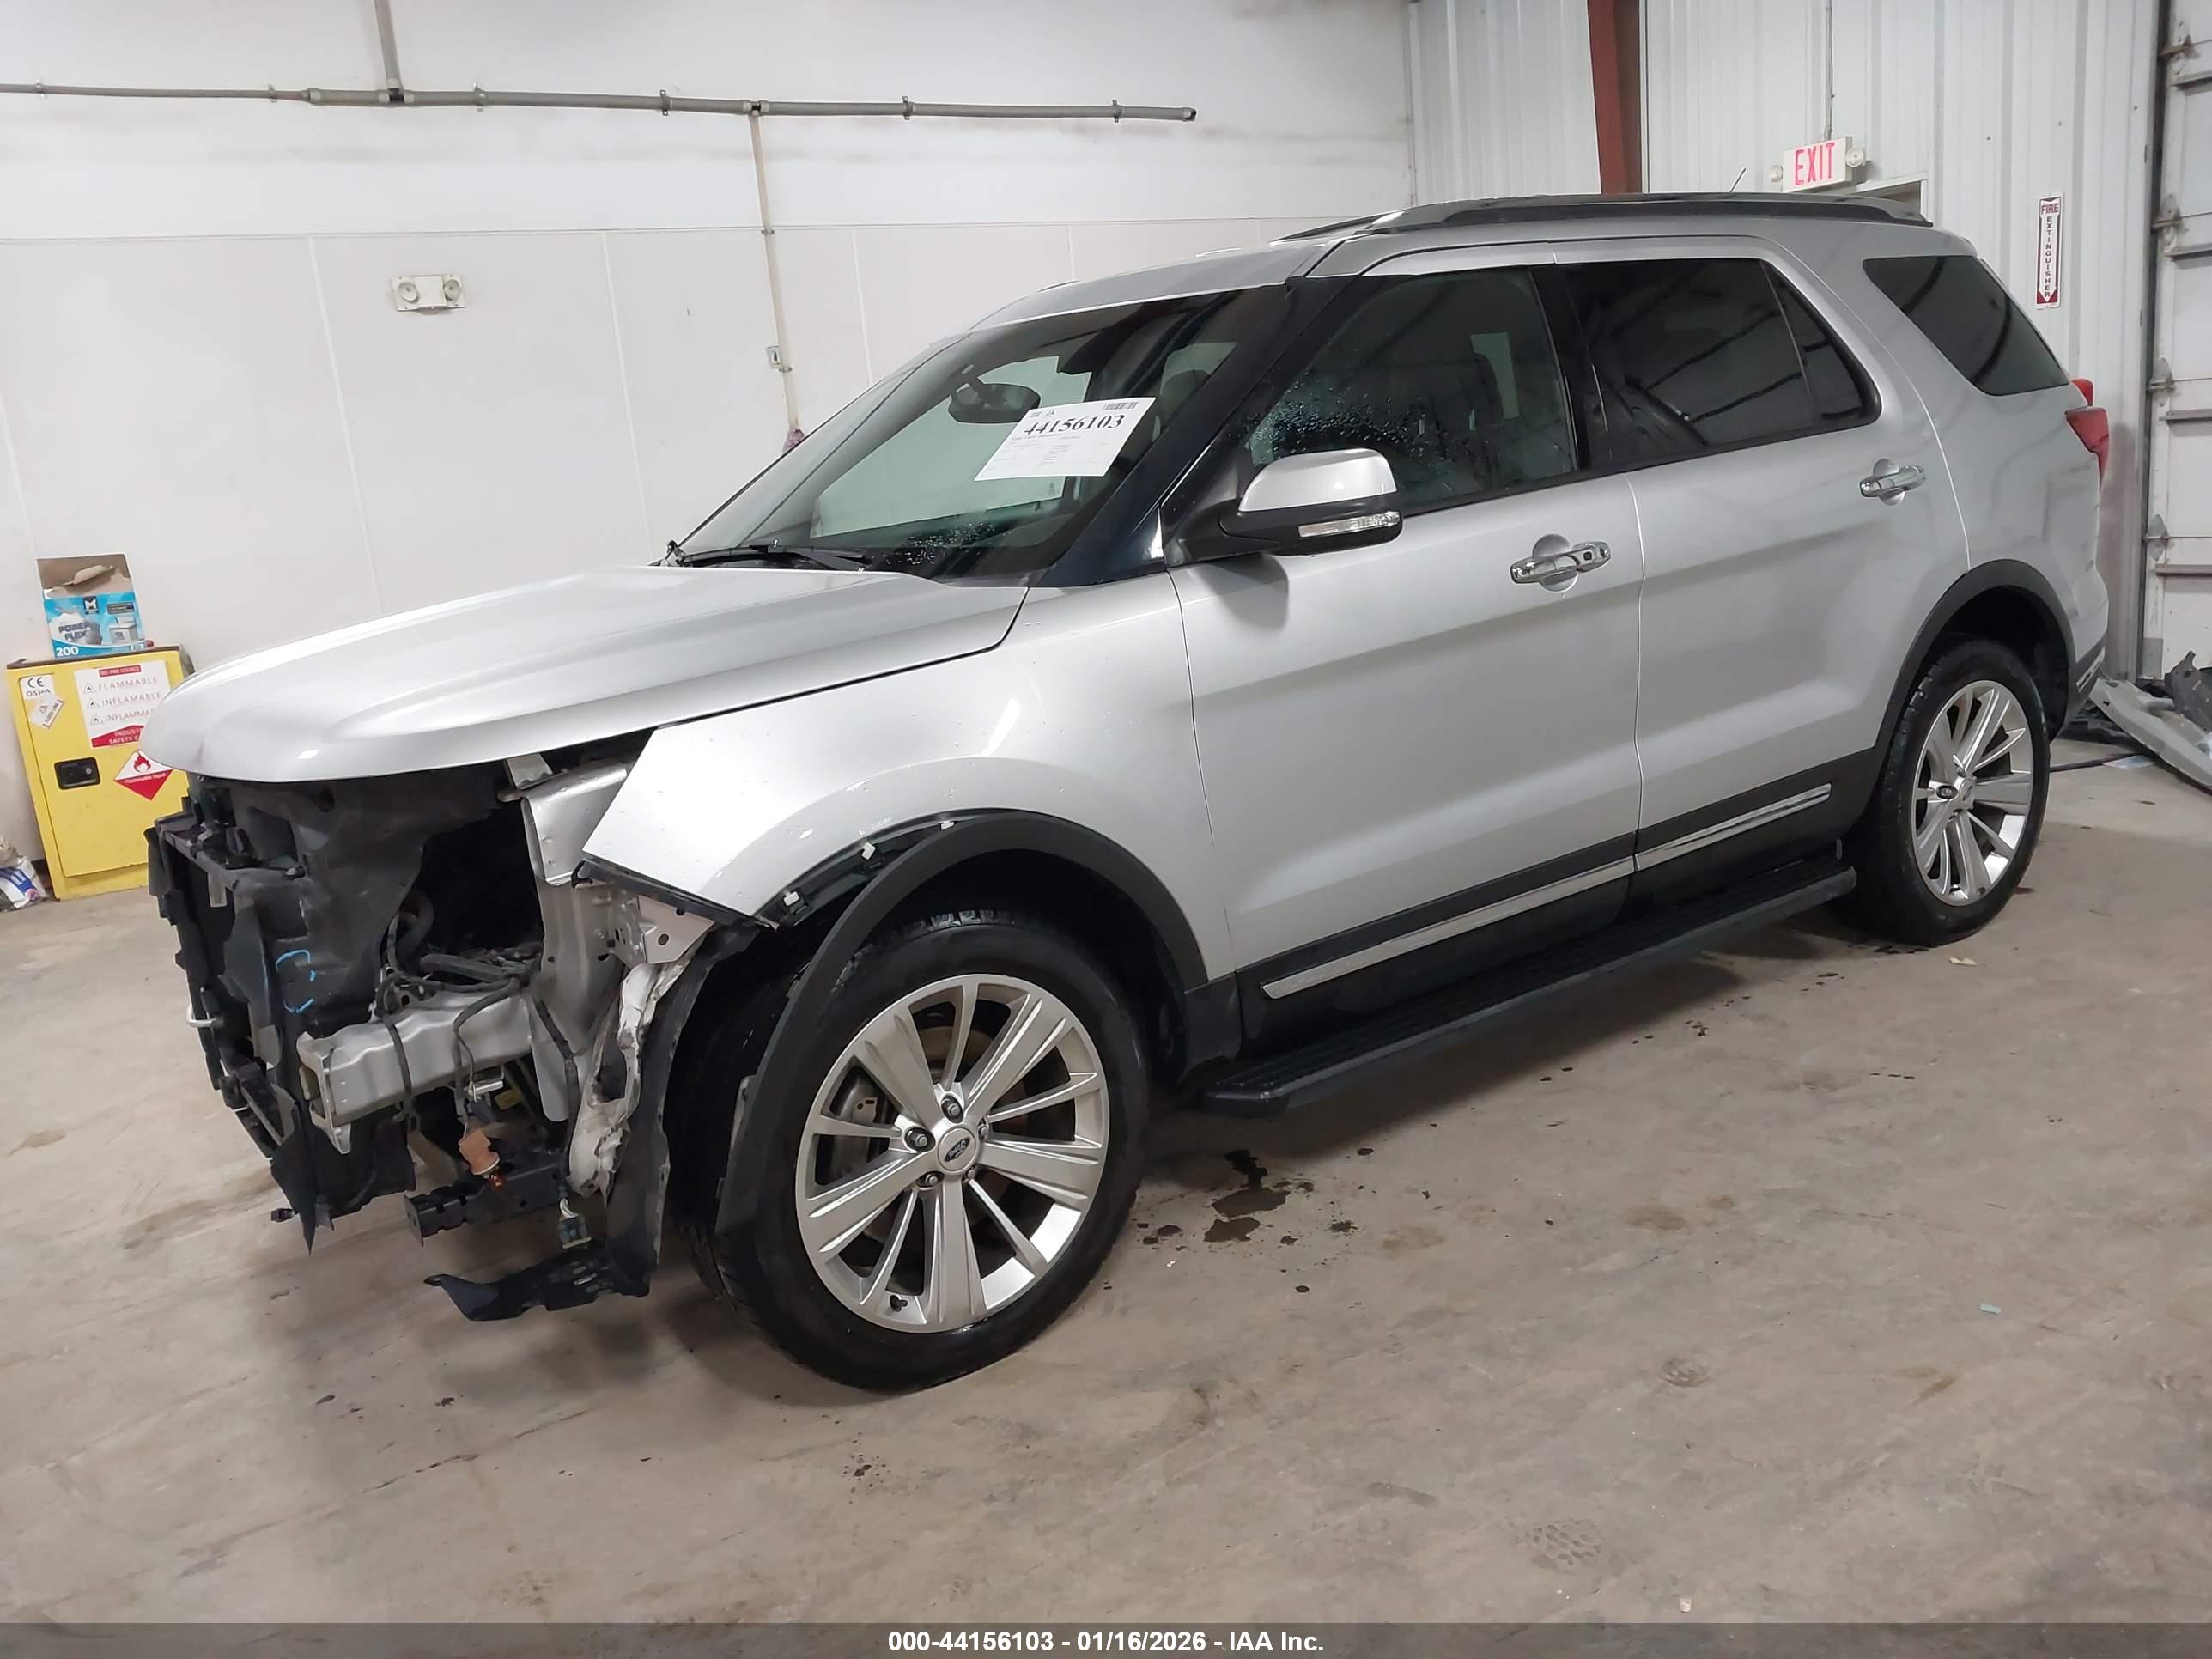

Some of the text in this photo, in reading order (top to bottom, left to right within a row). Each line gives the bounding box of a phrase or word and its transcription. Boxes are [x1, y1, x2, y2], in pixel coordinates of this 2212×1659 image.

[1795, 142, 1835, 185] EXIT
[2041, 204, 2059, 215] FIRE
[2044, 216, 2052, 297] EXTINGUISHER
[1024, 415, 1124, 434] 44156103
[58, 622, 92, 634] POWER
[56, 647, 79, 657] 200
[27, 677, 44, 688] CE
[97, 676, 158, 690] FLAMMABLE
[101, 692, 161, 707] INFLAMABLE
[108, 736, 132, 744] SAFETY
